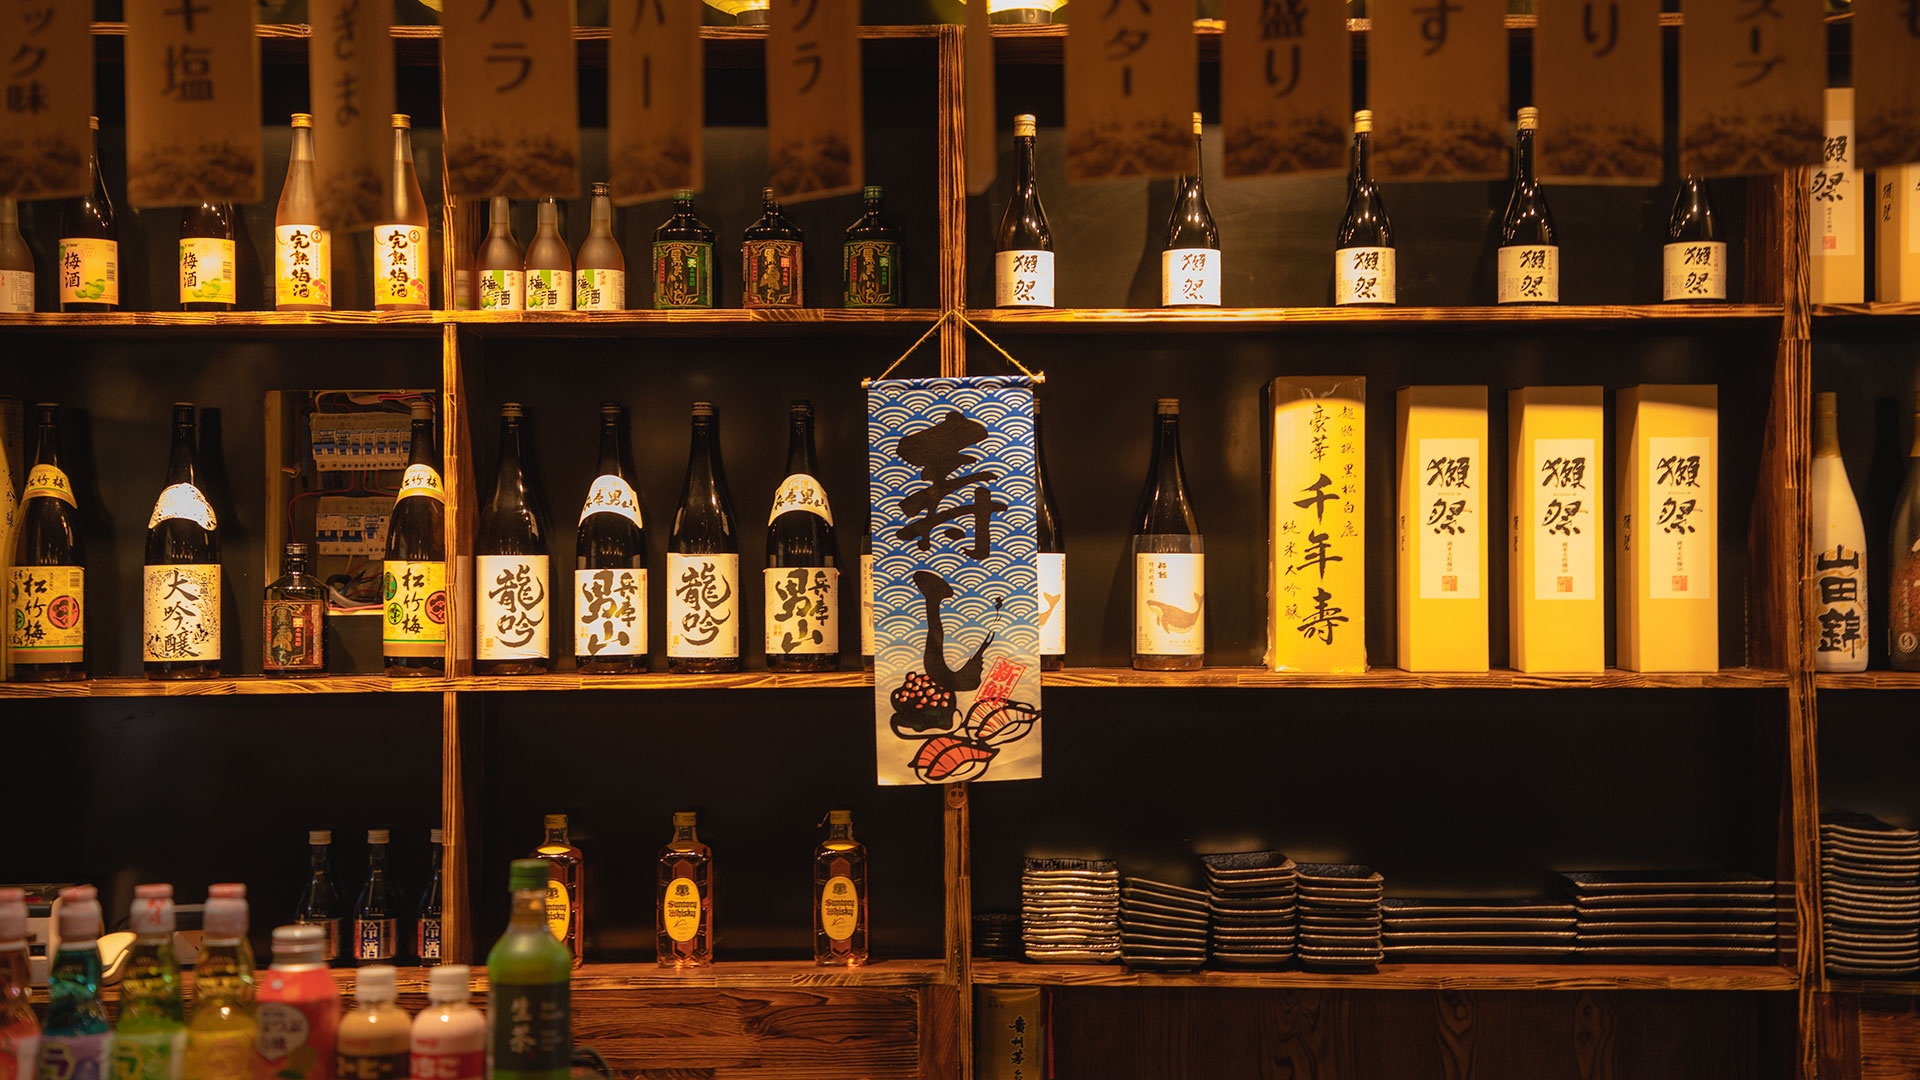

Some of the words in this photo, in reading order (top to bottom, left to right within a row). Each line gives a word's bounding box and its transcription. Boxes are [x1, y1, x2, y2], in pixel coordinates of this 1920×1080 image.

[64, 251, 82, 289] 梅酒
[183, 251, 198, 289] 梅酒
[290, 230, 313, 298] 完熟梅酒
[388, 230, 411, 298] 完熟梅酒
[1012, 254, 1039, 302] 獺祭
[1181, 253, 1207, 300] 獺祭
[1353, 251, 1380, 299] 獺祭
[1519, 249, 1547, 298] 獺祭
[1684, 246, 1712, 294] 獺祭
[1426, 456, 1473, 536] 獺祭
[1541, 457, 1589, 537] 獺祭
[1656, 455, 1704, 535] 獺祭
[896, 411, 1008, 691] 寿し
[23, 573, 48, 641] 松竹梅
[163, 569, 200, 658] 大吟醸
[401, 567, 425, 635] 松竹梅
[488, 564, 545, 648] 龍吟
[675, 562, 732, 646] 龍吟
[1816, 544, 1863, 660] 山田錦
[667, 900, 698, 910] Suntory
[668, 909, 697, 919] Whisky
[824, 899, 855, 909] Suntory
[825, 907, 854, 917] Whisky
[362, 921, 379, 959] 冷酒
